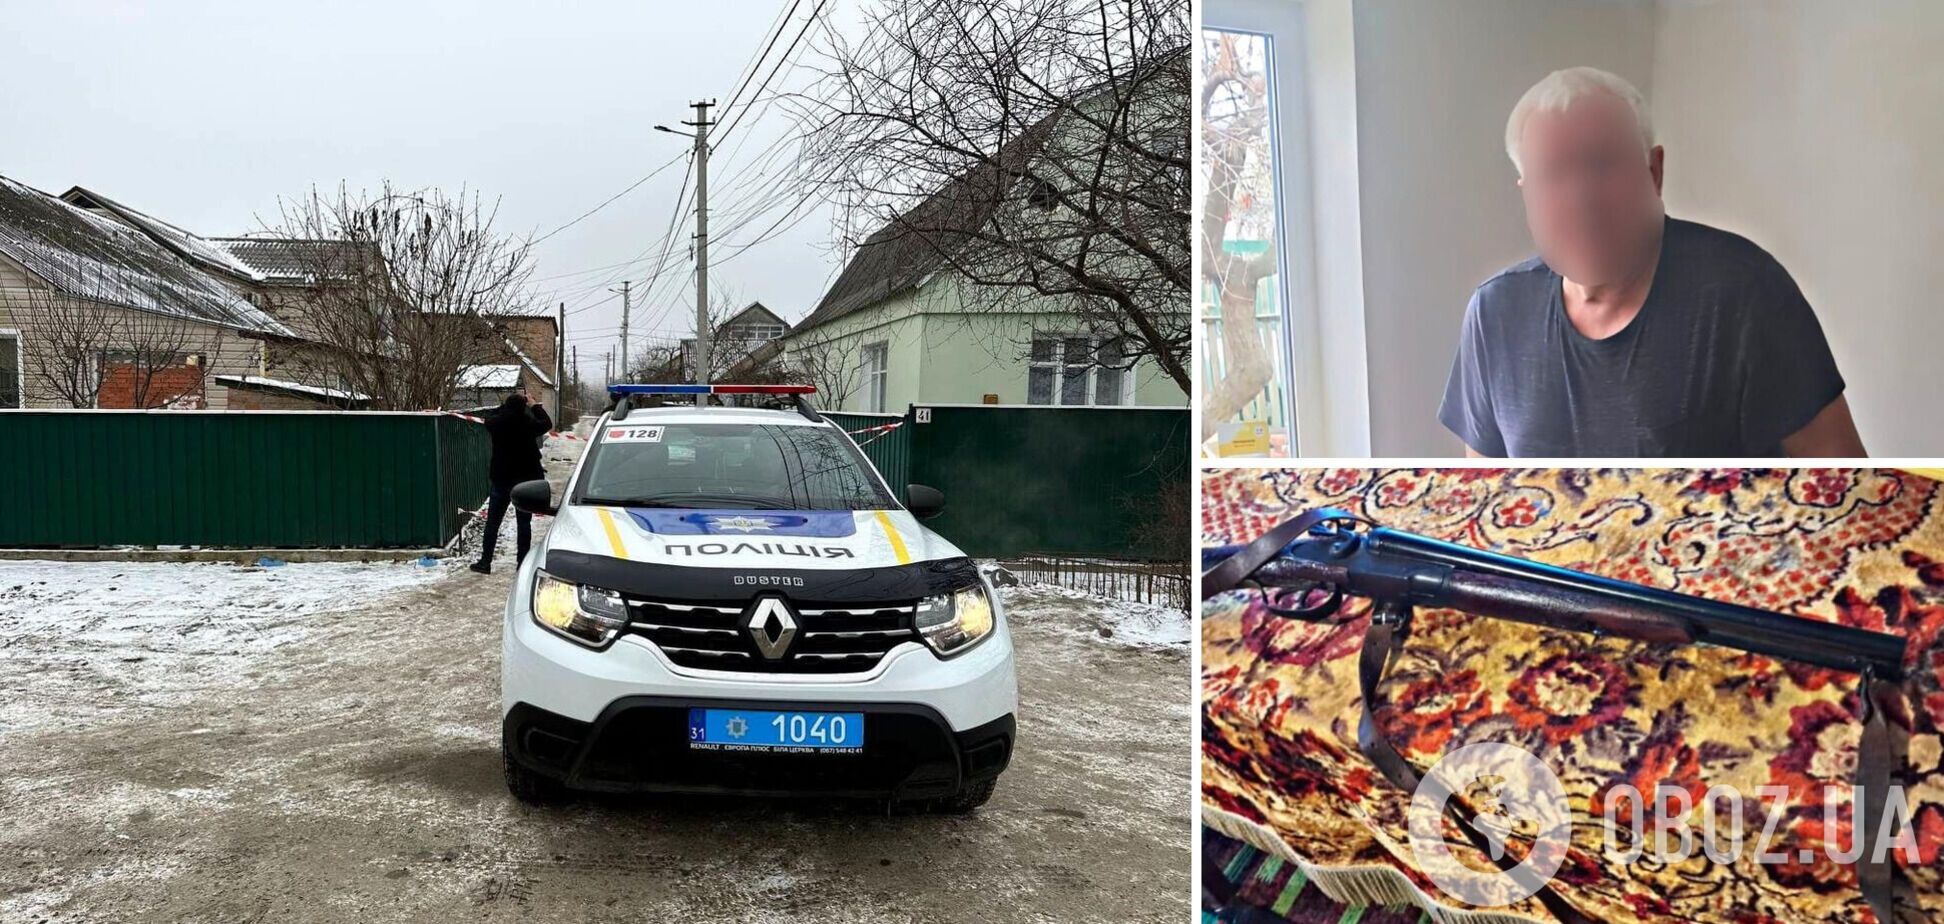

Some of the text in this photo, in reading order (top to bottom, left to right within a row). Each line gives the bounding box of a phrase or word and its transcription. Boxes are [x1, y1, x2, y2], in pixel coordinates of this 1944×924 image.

[918, 410, 929, 421] 41
[628, 430, 658, 438] 128
[665, 543, 855, 558] ПОЛІЦІЯ
[734, 575, 804, 587] DUSTER
[690, 714, 846, 743] 31 1040
